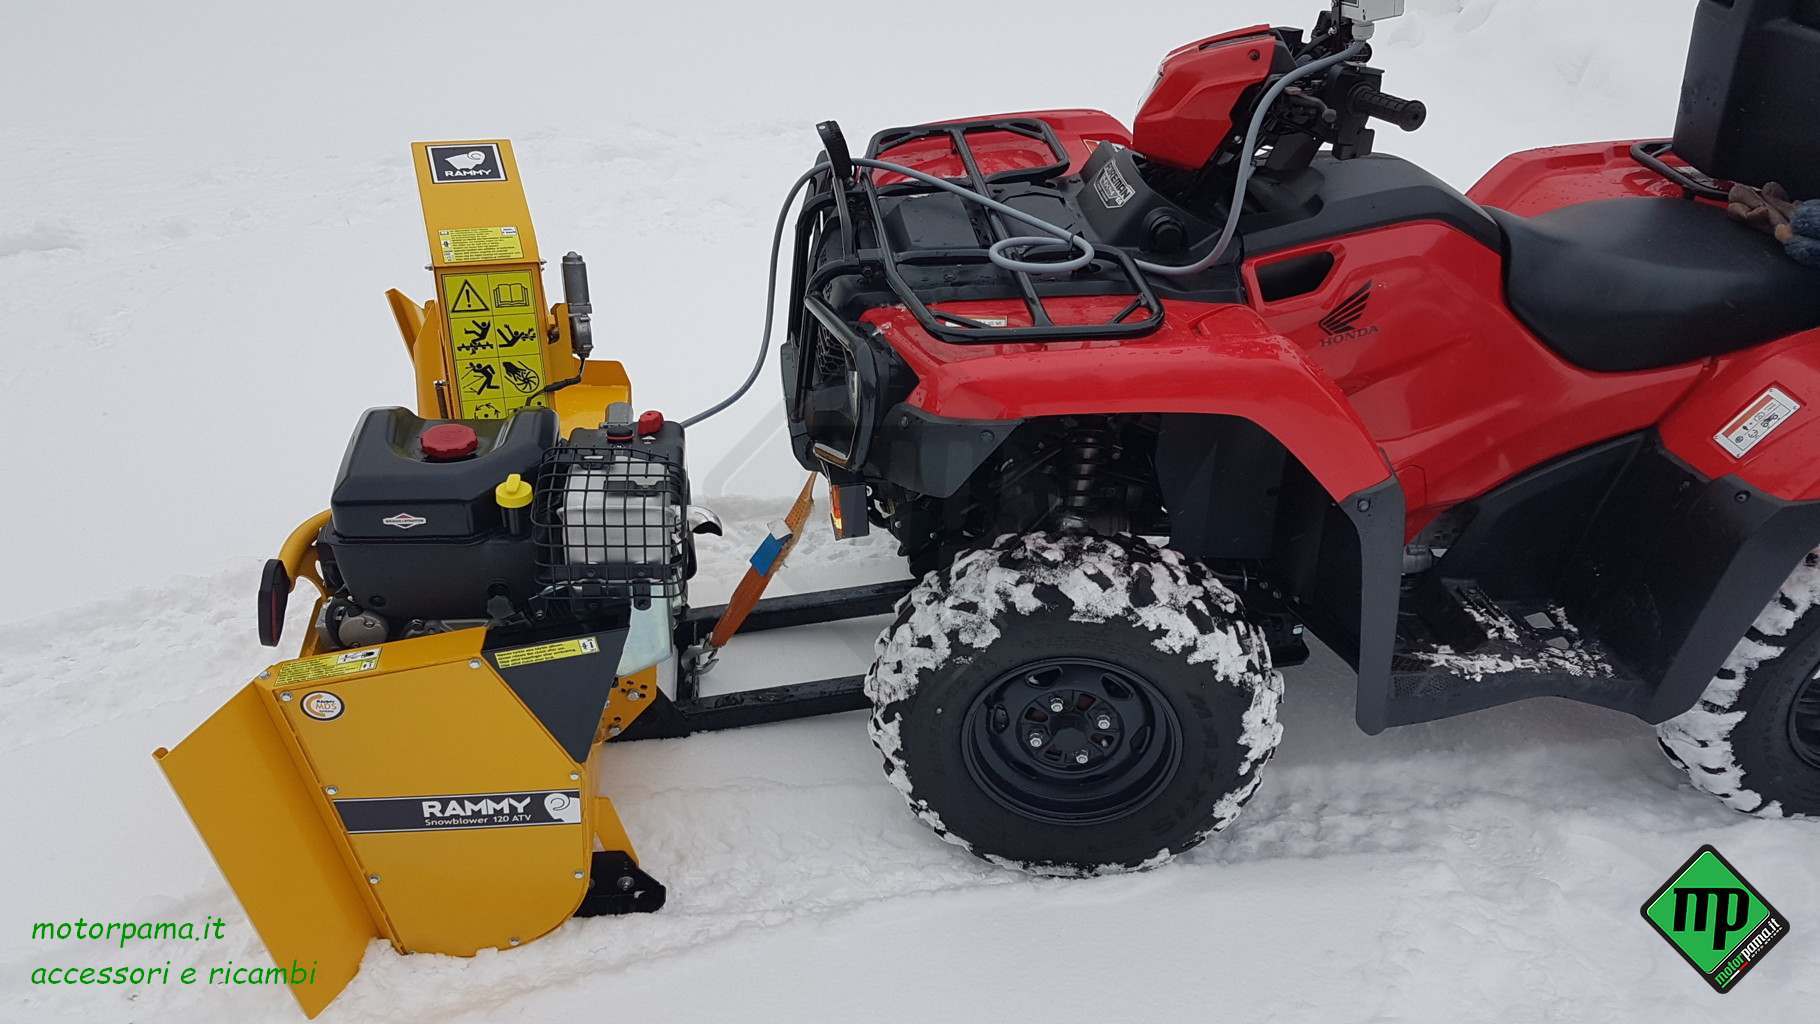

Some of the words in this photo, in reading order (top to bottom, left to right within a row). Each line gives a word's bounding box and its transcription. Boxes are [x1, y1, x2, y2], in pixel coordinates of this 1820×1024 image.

[444, 169, 492, 177] RAMMY
[1104, 162, 1132, 200] FOREMAN
[1319, 325, 1379, 347] HONDA
[422, 797, 531, 818] RAMMY
[425, 817, 488, 827] Snowblower
[493, 815, 509, 824] 120
[512, 814, 532, 822] ATV
